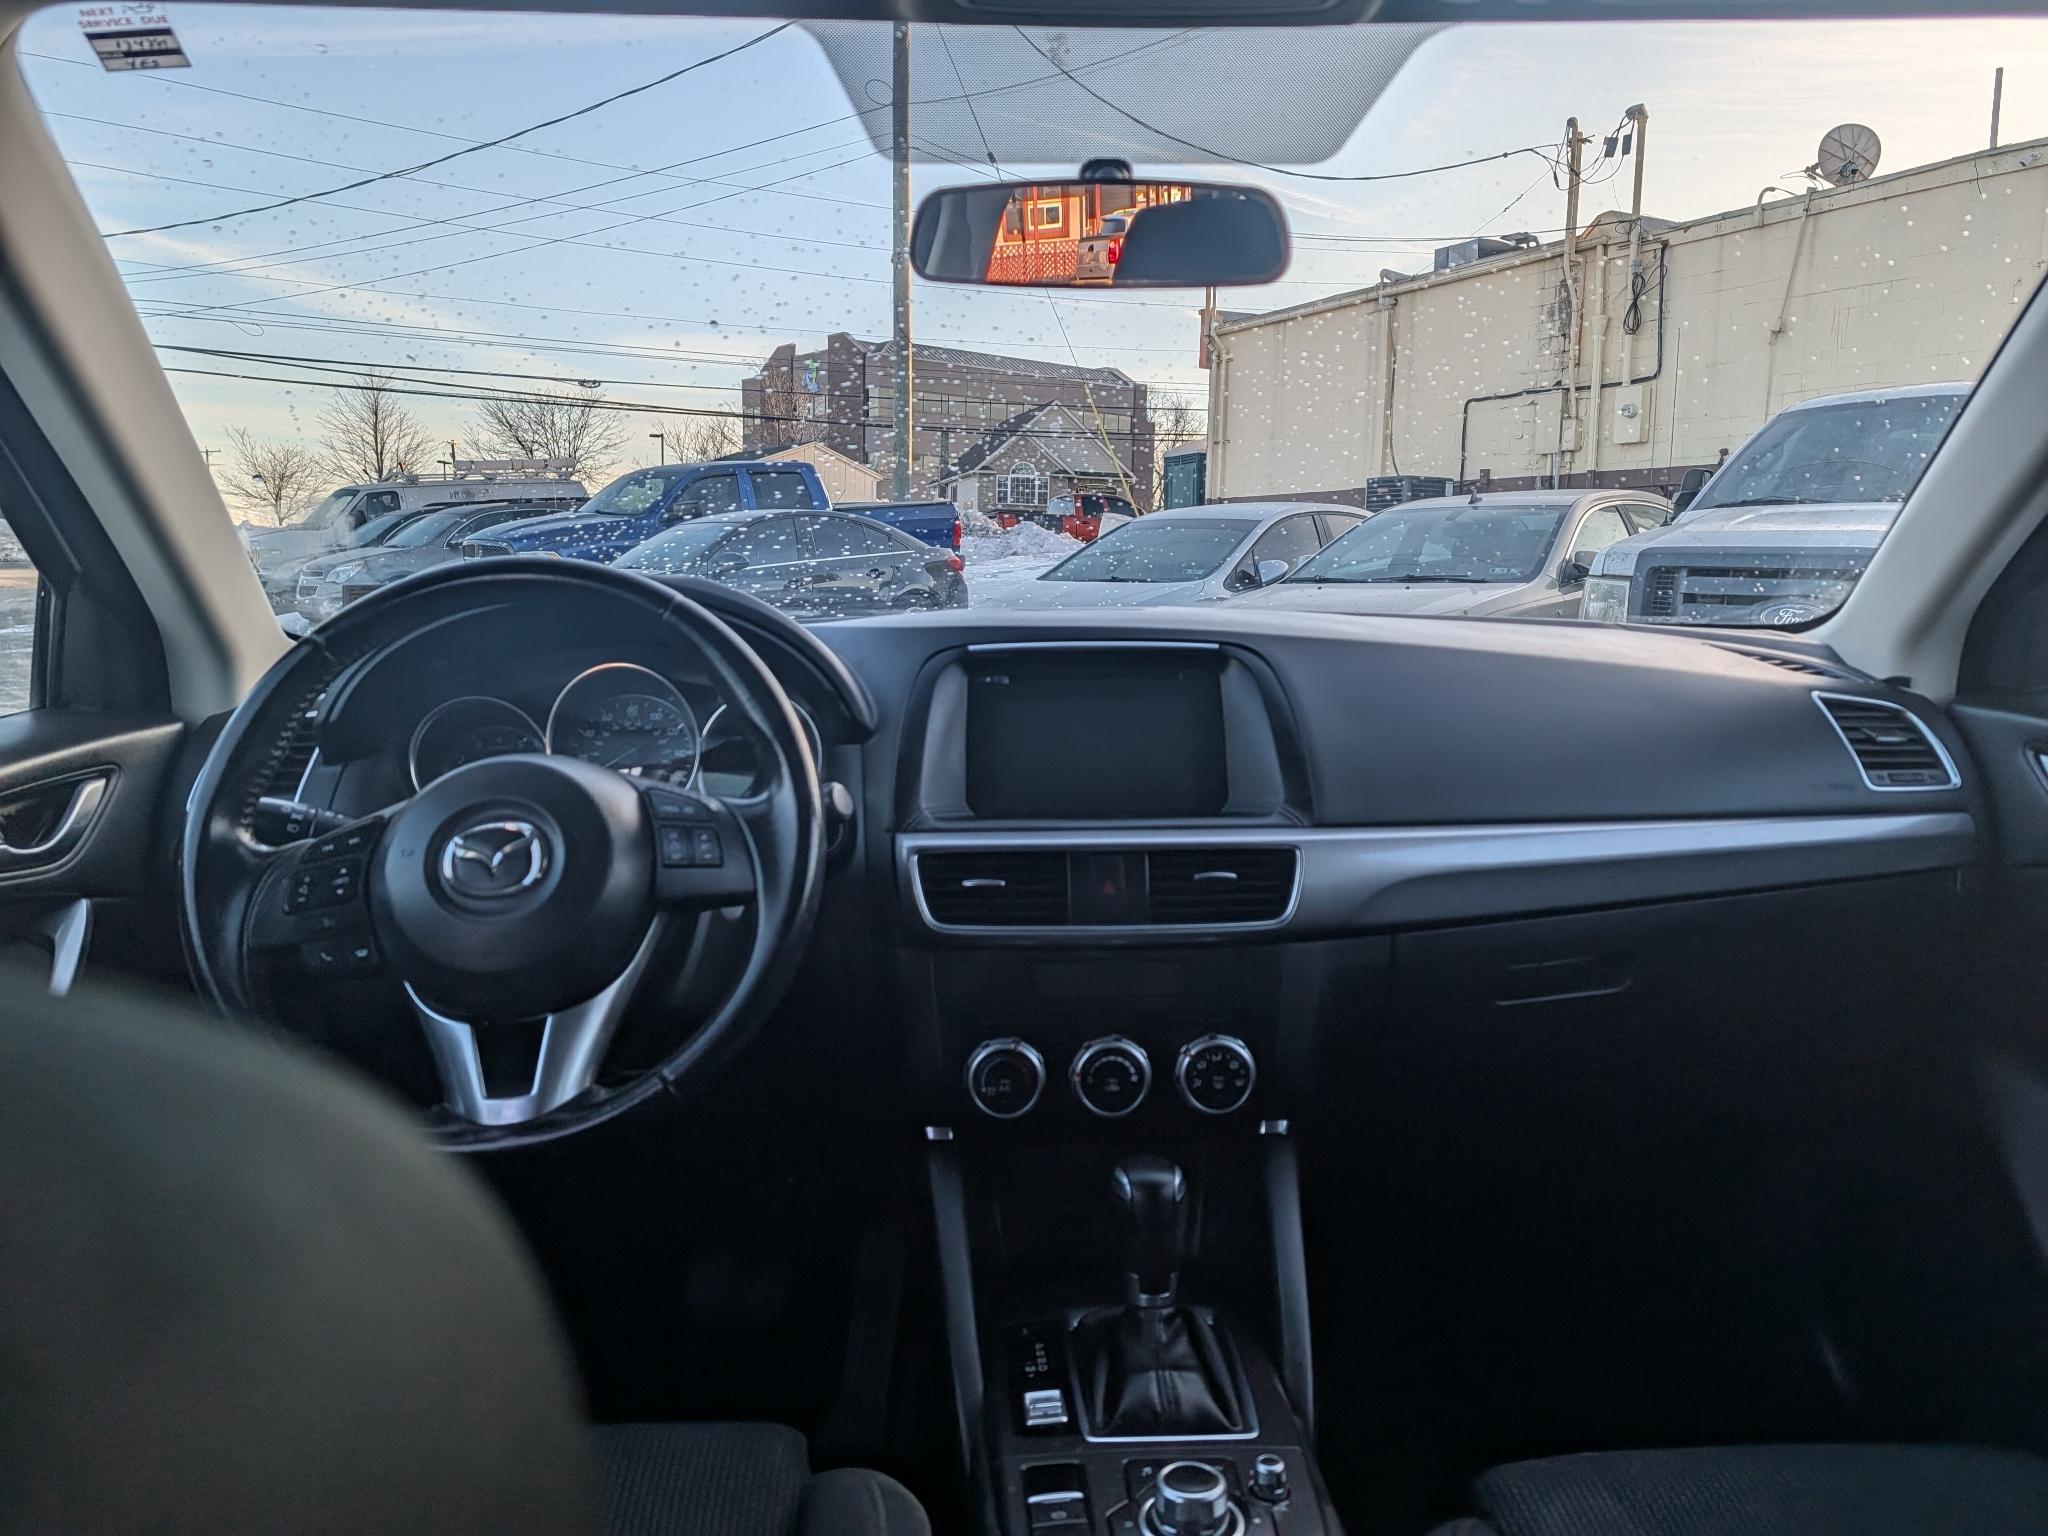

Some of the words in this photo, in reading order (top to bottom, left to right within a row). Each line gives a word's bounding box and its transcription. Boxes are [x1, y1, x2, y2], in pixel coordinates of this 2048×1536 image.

[79, 7, 113, 17] NEXT
[78, 17, 135, 28] SERVICE
[140, 14, 169, 25] DUE
